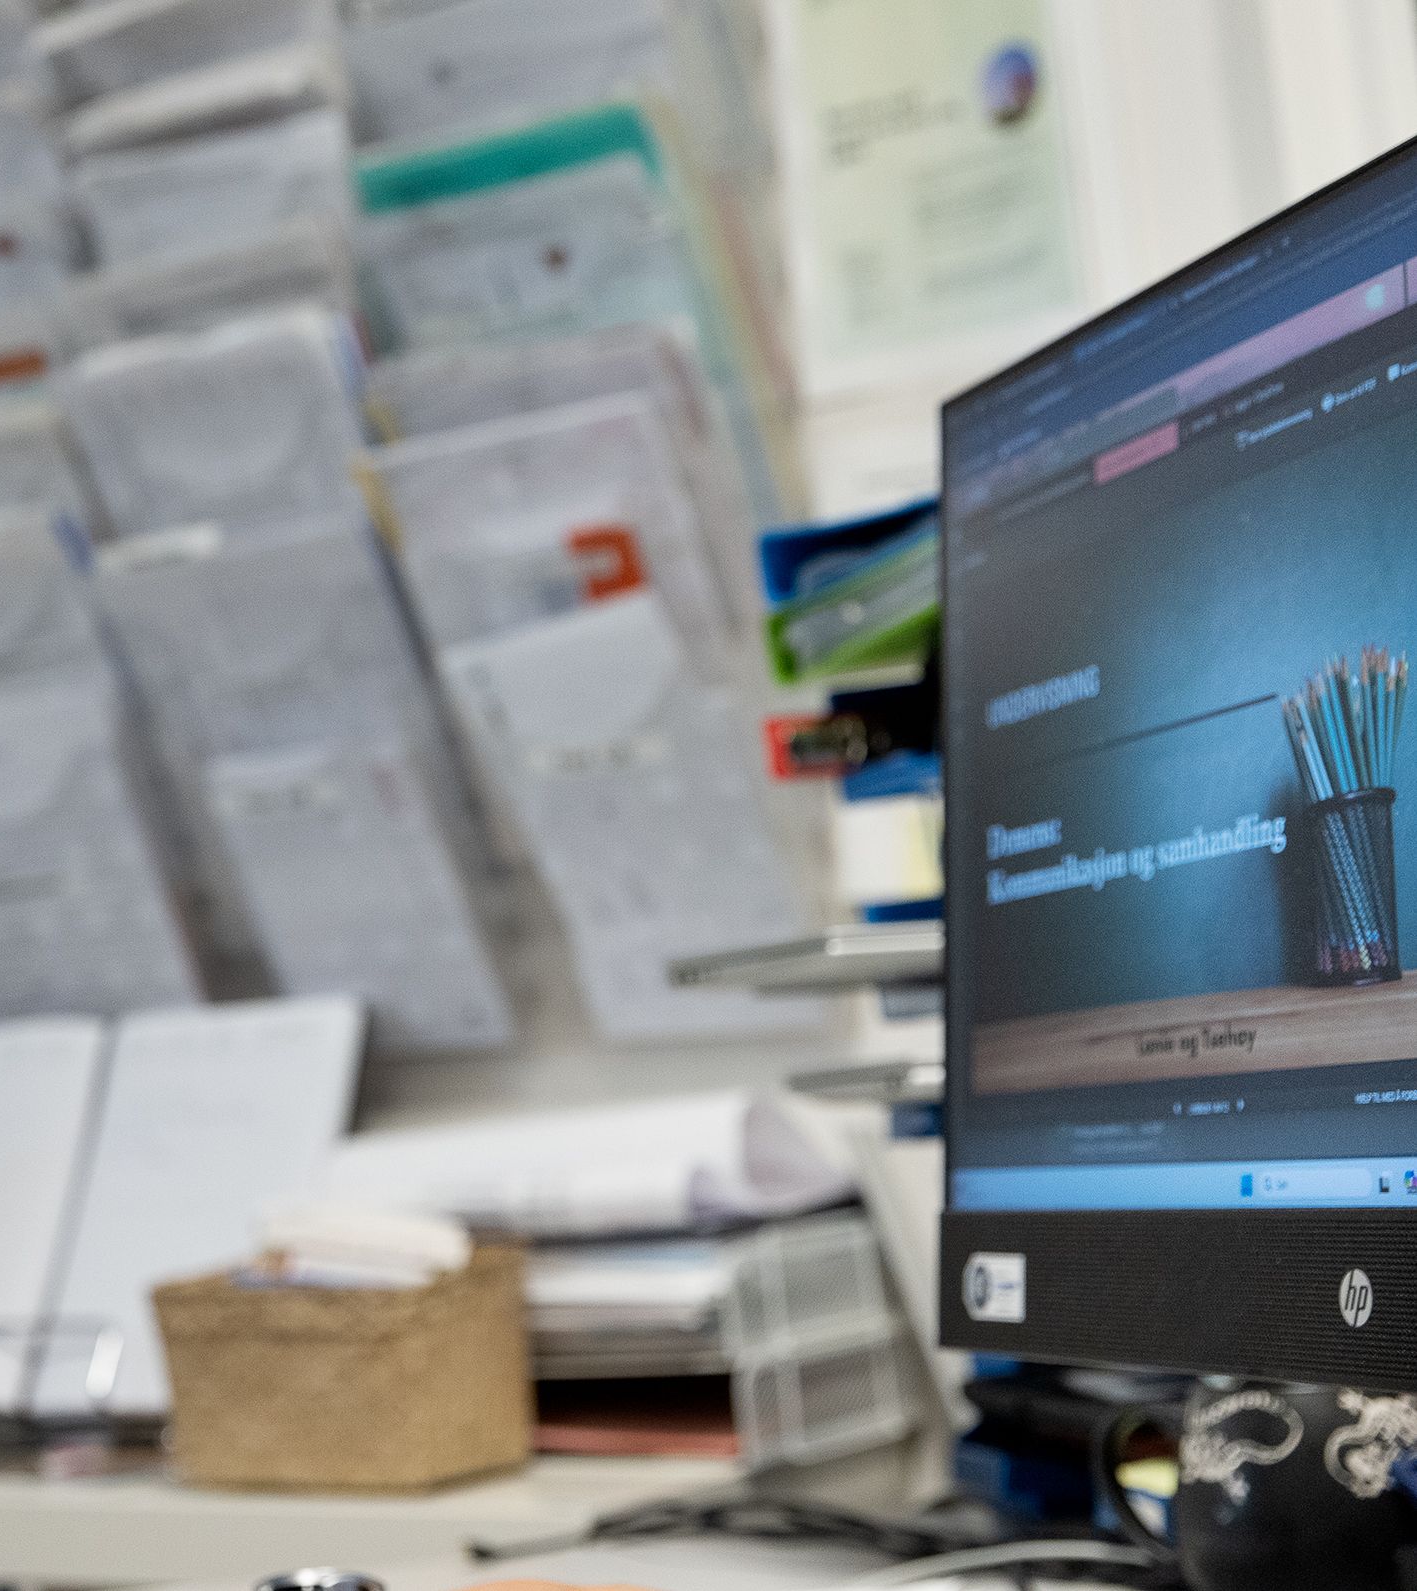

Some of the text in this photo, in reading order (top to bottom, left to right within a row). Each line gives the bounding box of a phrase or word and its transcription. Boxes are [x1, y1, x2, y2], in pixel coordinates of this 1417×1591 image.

[1128, 844, 1156, 881] og
[1156, 813, 1286, 870] samhandling
[1180, 1036, 1198, 1057] og
